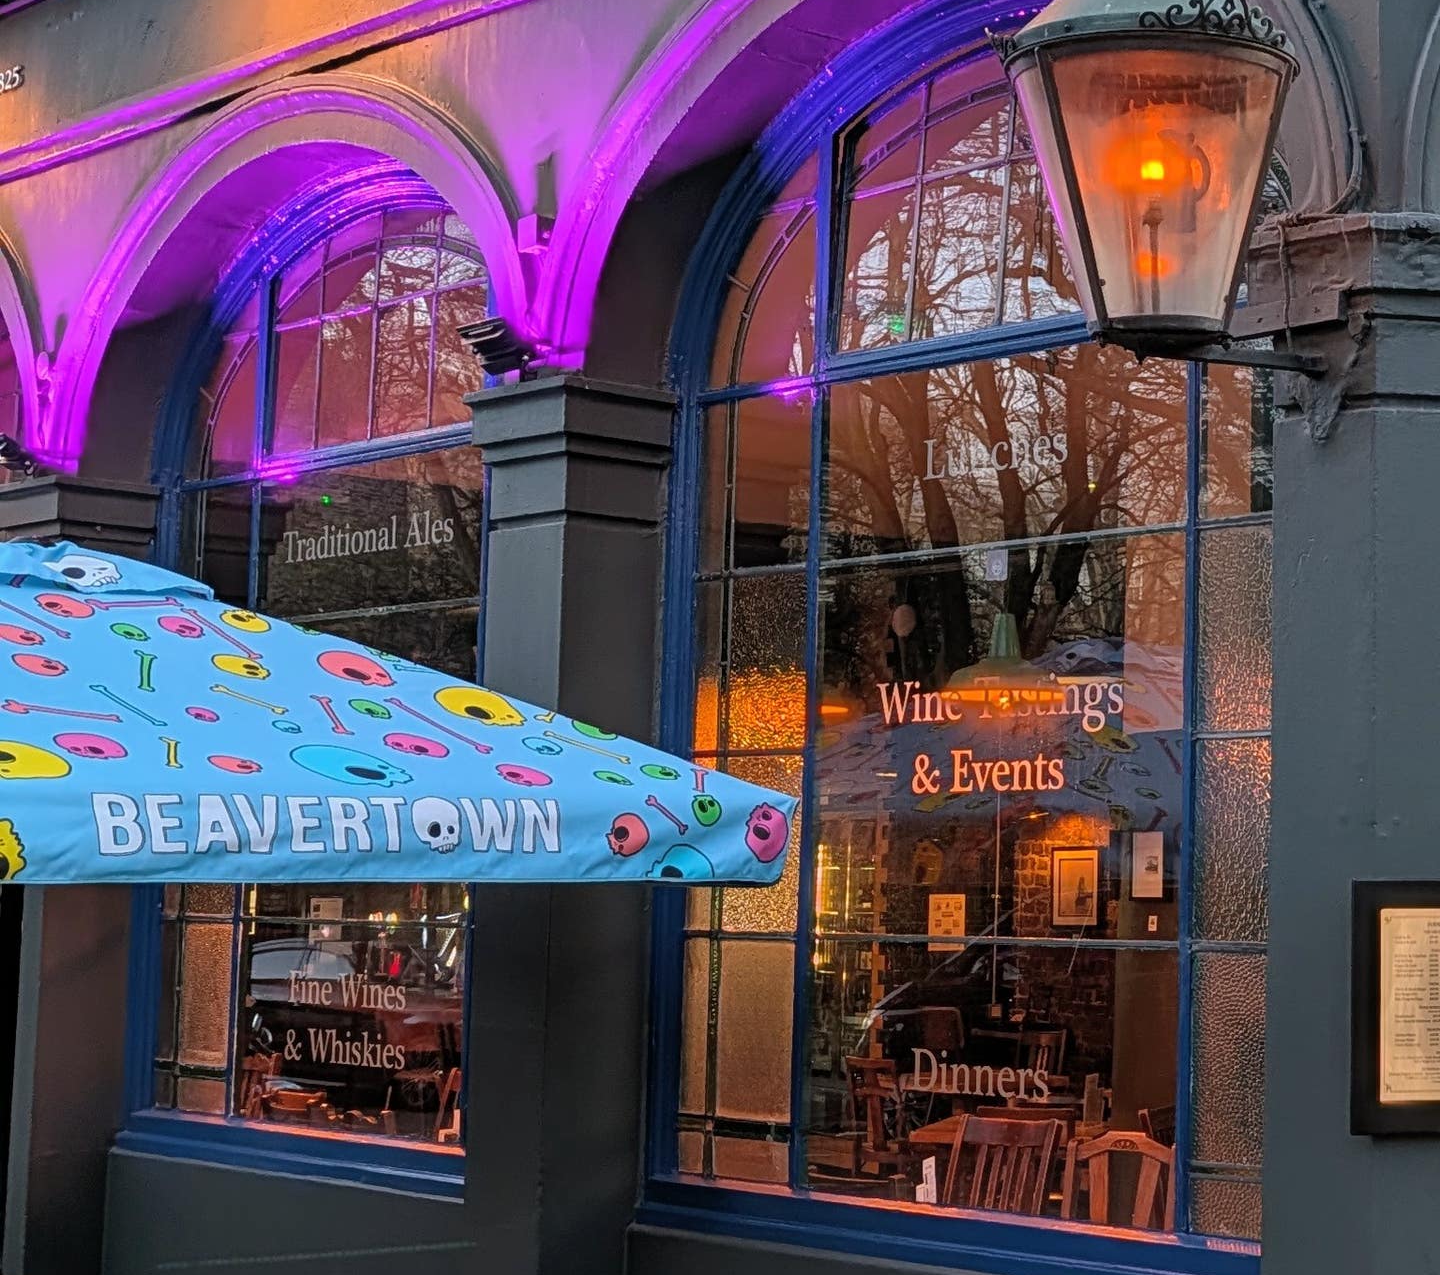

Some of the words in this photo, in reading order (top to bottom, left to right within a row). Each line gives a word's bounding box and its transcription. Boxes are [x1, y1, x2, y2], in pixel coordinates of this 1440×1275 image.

[924, 433, 1069, 481] Lunches
[283, 515, 397, 563] Traditional
[404, 510, 455, 548] Ales
[911, 754, 941, 794] &
[950, 749, 1065, 793] Events
[288, 970, 333, 1006] Fine
[339, 969, 407, 1010] Wines
[284, 1028, 302, 1061] &
[307, 1028, 406, 1070] Whiskies
[911, 1047, 1050, 1101] Dinners
